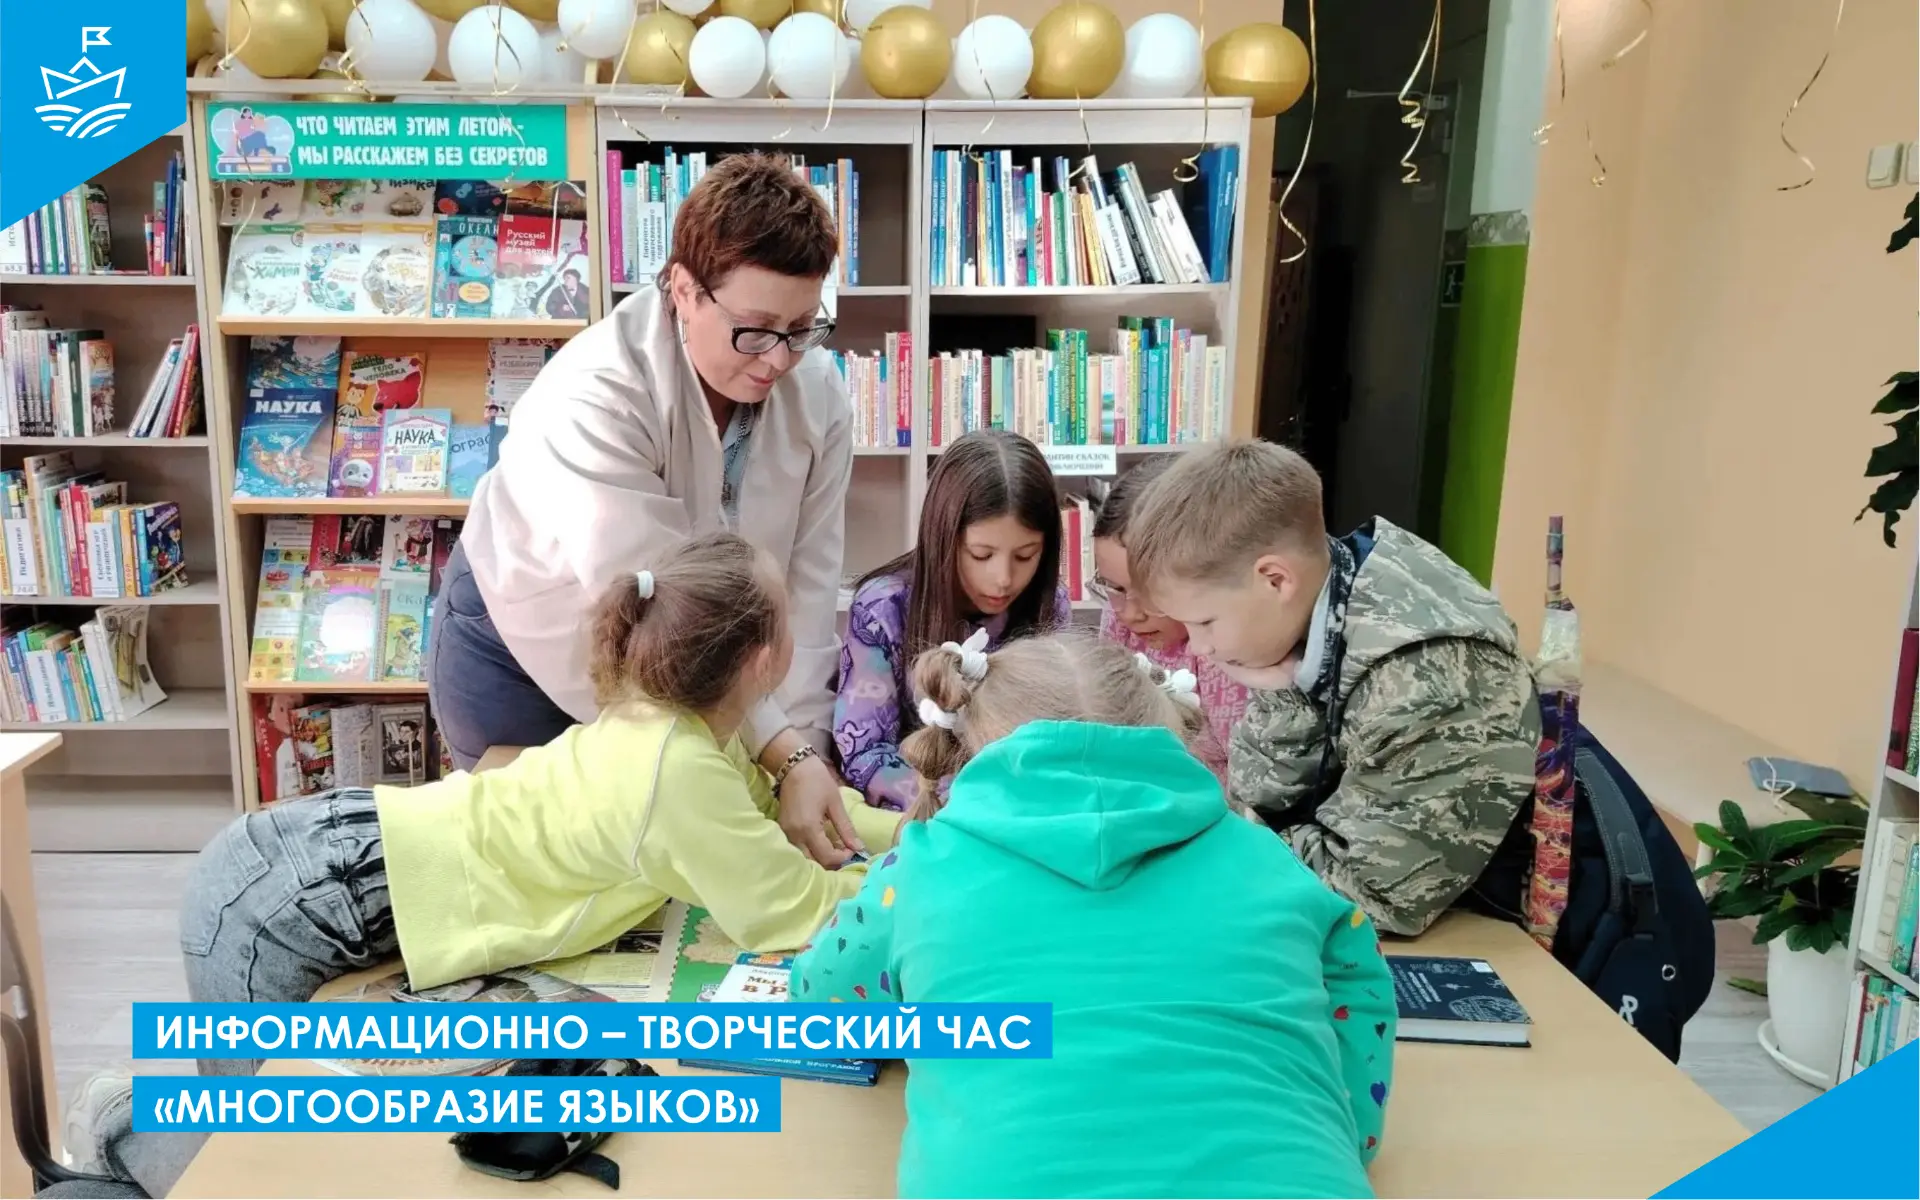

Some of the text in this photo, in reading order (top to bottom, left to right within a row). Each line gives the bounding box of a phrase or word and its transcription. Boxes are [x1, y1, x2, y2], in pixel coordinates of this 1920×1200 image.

[297, 116, 328, 136] ЧТО
[333, 116, 397, 136] ЧИТАЕМ
[406, 116, 450, 136] ЭТИМ
[458, 116, 512, 136] ЛЕТОМ
[298, 146, 548, 167] МЫ РАССКАЖЕМ БЕЗ СЕКРЕТОВ
[507, 229, 545, 241] Русский
[505, 240, 536, 248] музей
[255, 400, 322, 414] НАУКА
[395, 428, 436, 446] НАУКА
